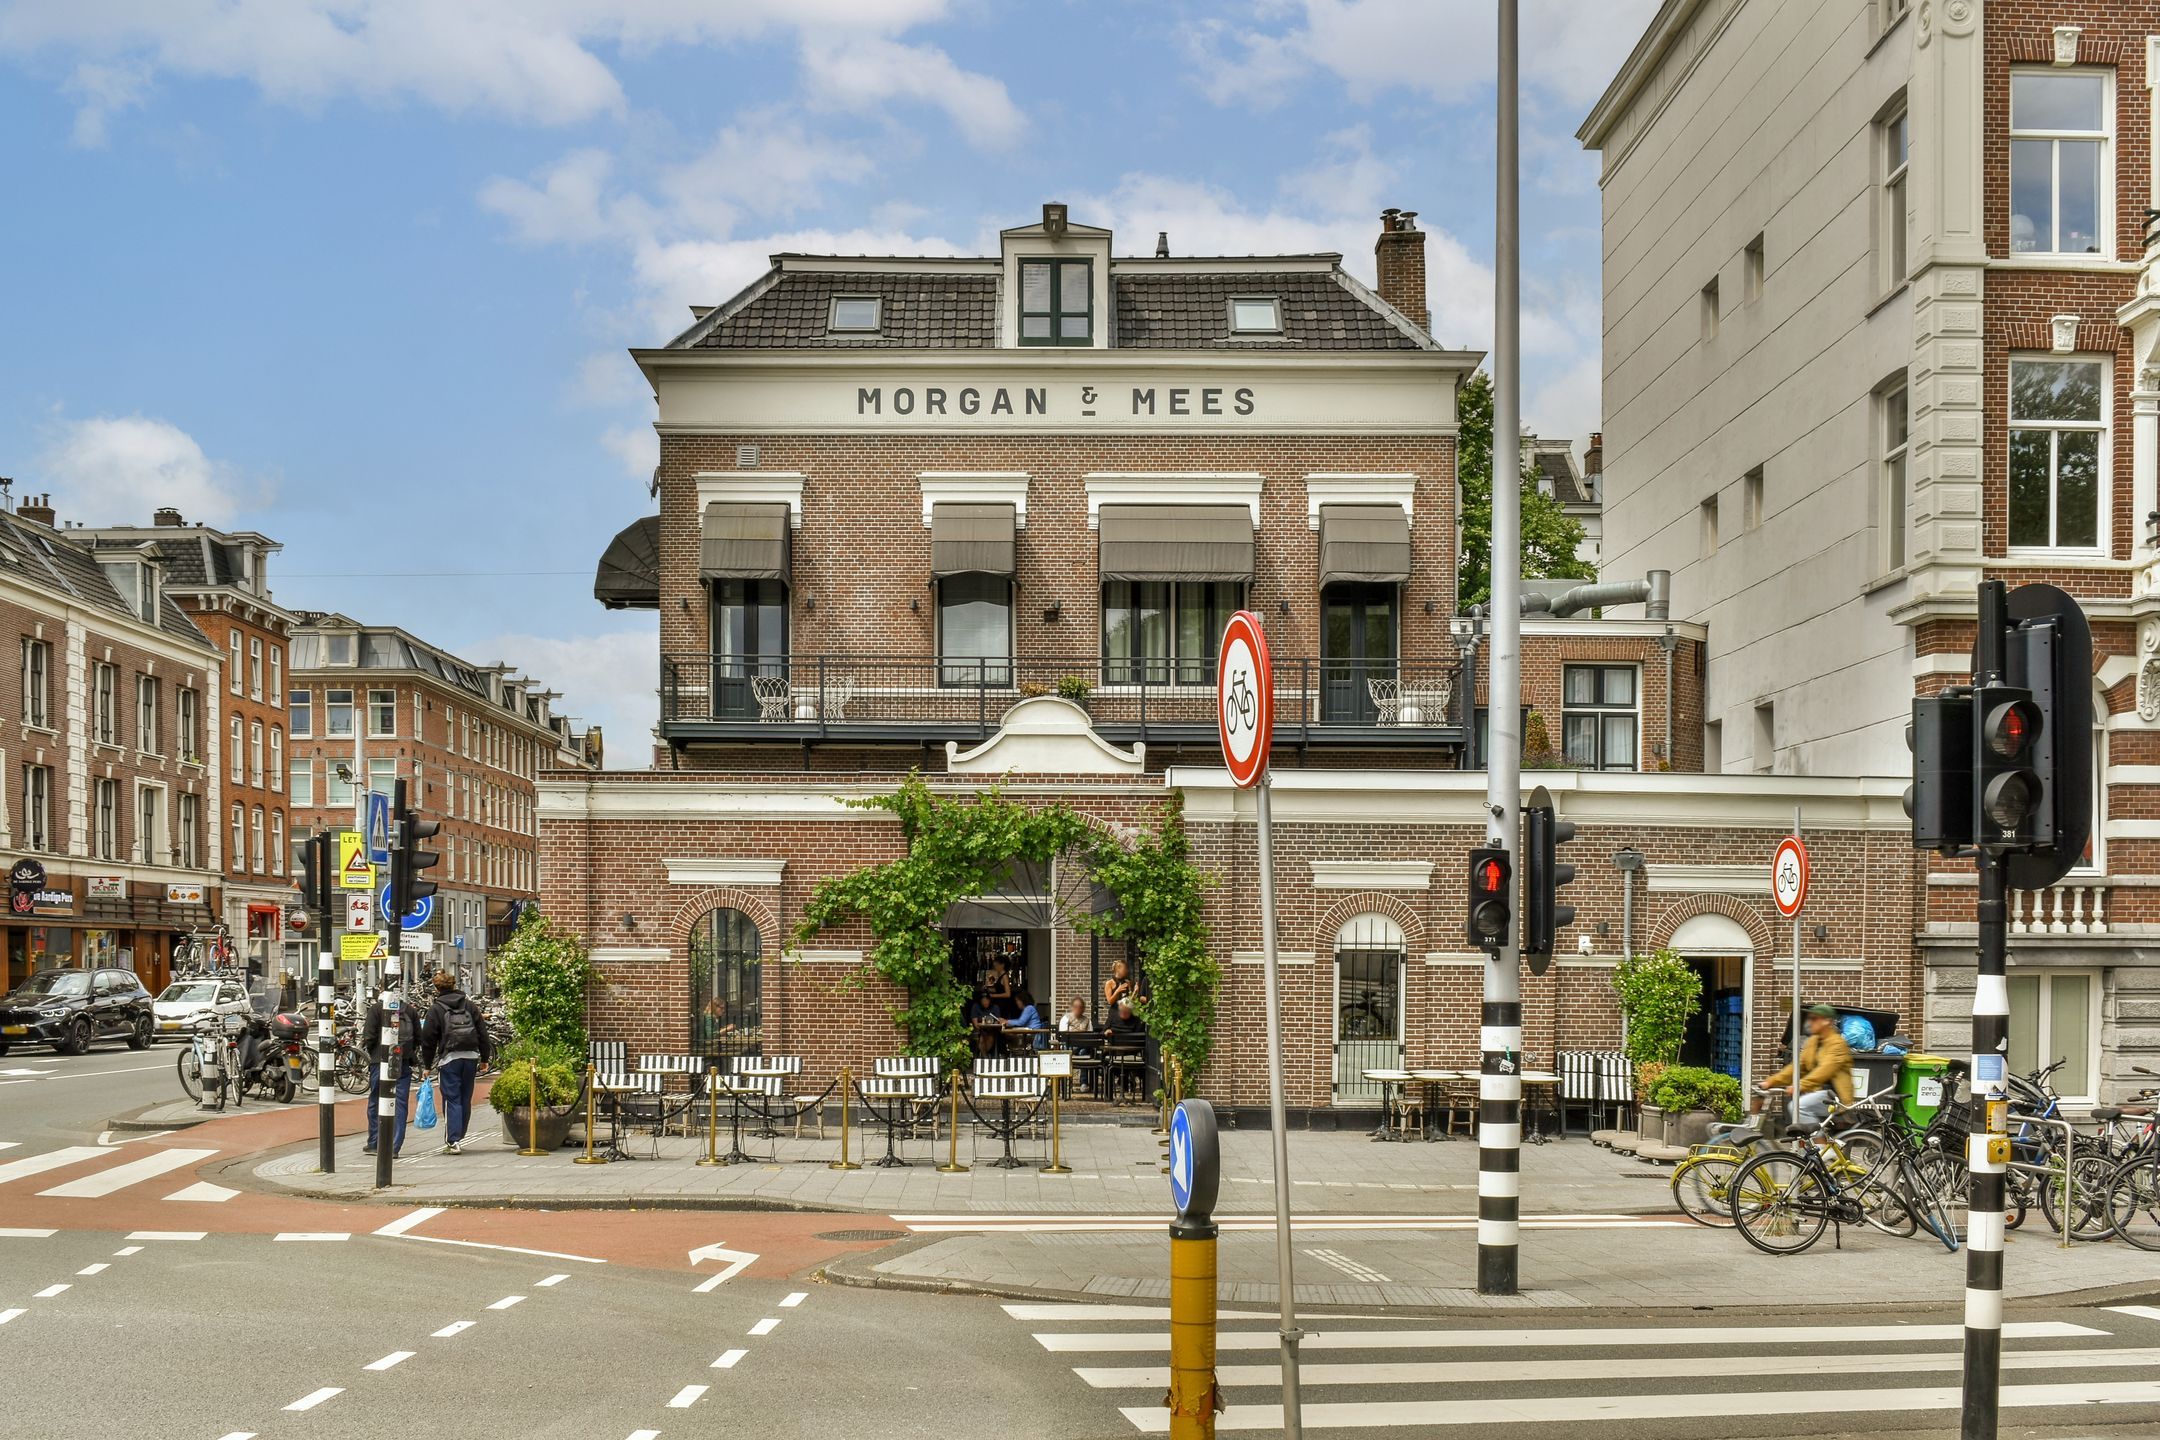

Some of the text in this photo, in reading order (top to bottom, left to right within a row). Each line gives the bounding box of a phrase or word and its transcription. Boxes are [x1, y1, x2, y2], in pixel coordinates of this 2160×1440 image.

[857, 386, 1256, 416] MORGAN & MEES
[2002, 830, 2015, 838] 381
